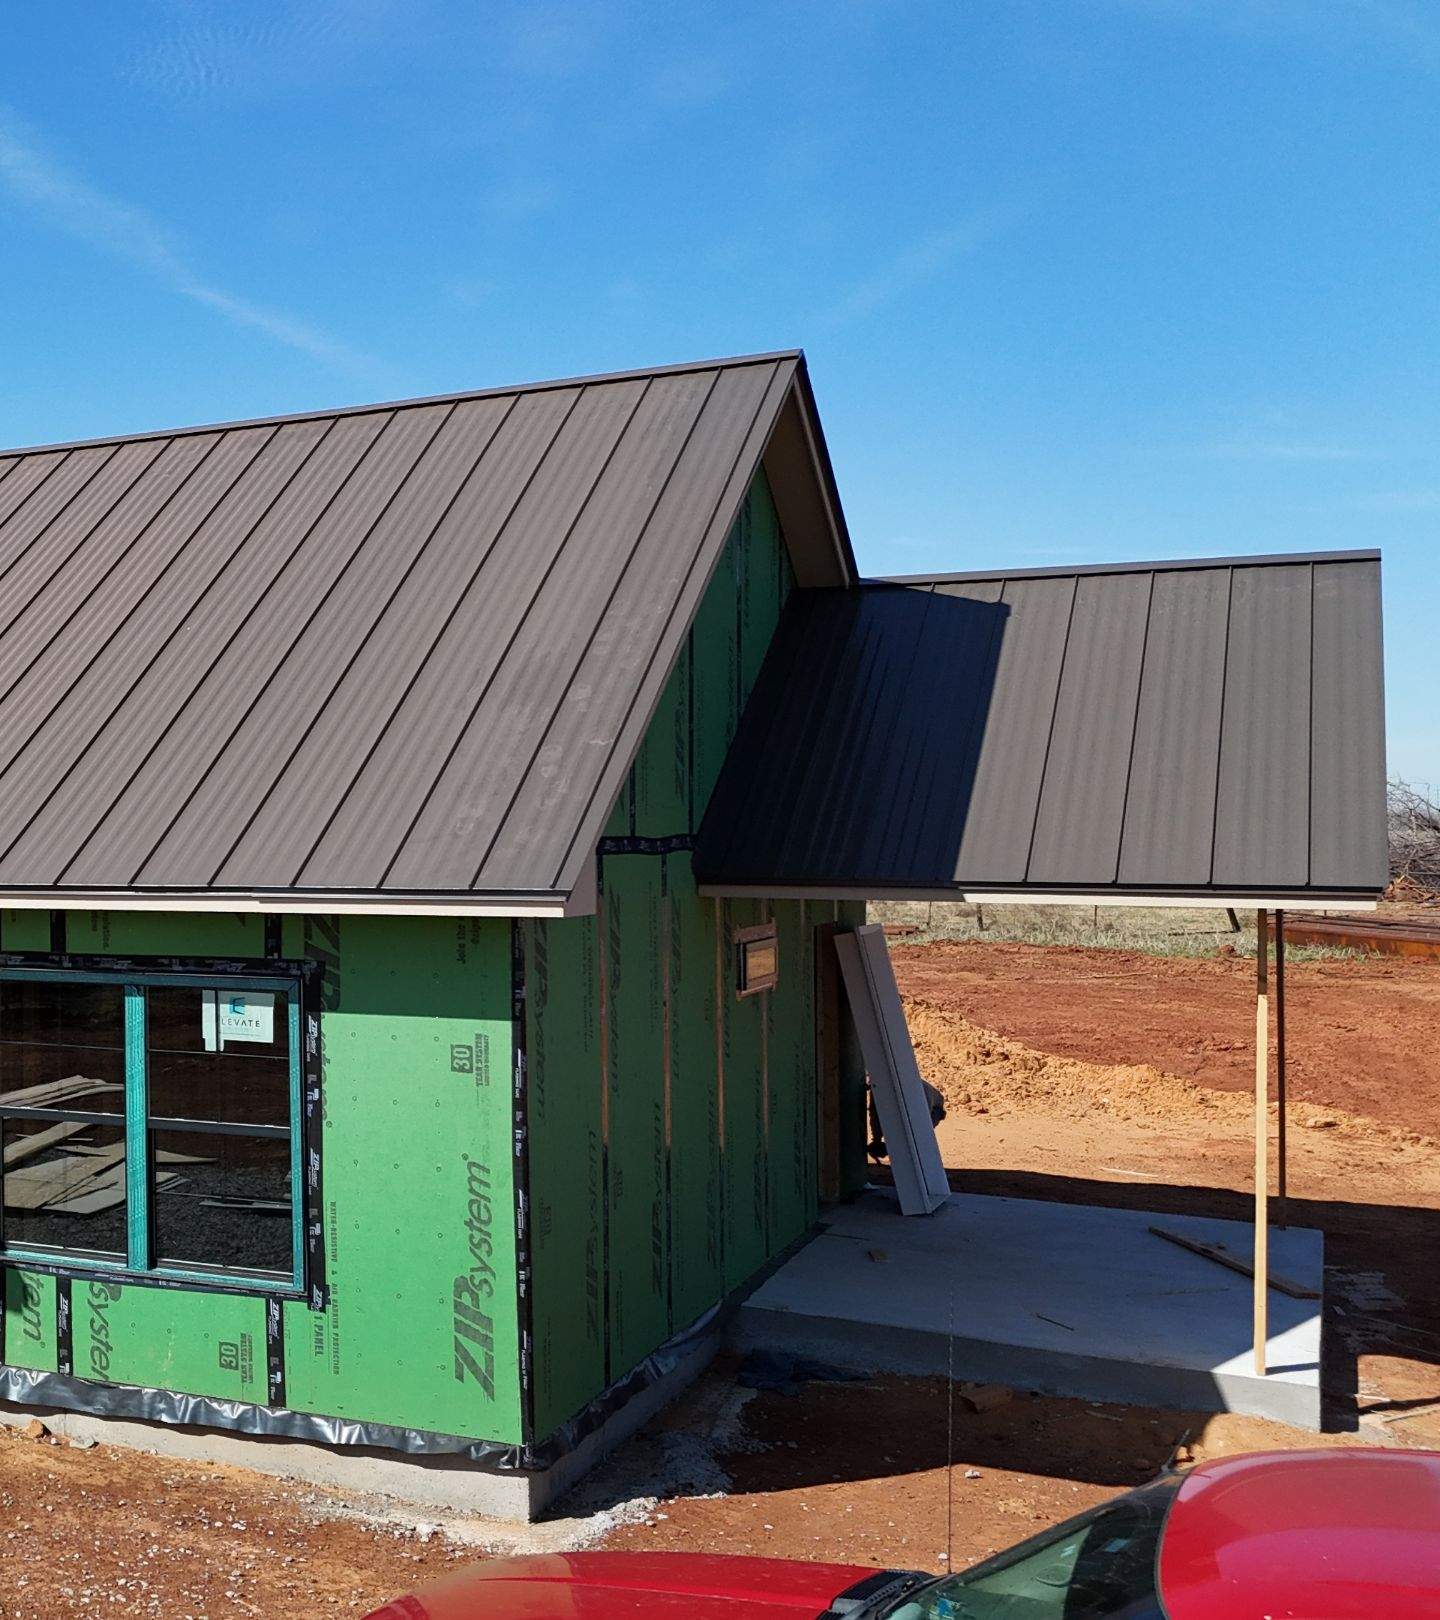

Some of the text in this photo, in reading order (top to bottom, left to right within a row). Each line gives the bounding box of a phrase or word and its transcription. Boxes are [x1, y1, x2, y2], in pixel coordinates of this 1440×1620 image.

[221, 1018, 261, 1028] LEVATE
[453, 1046, 470, 1070] 30
[453, 1159, 495, 1403] ZIPsystem
[314, 1324, 324, 1357] PANEL
[221, 1344, 237, 1368] 30
